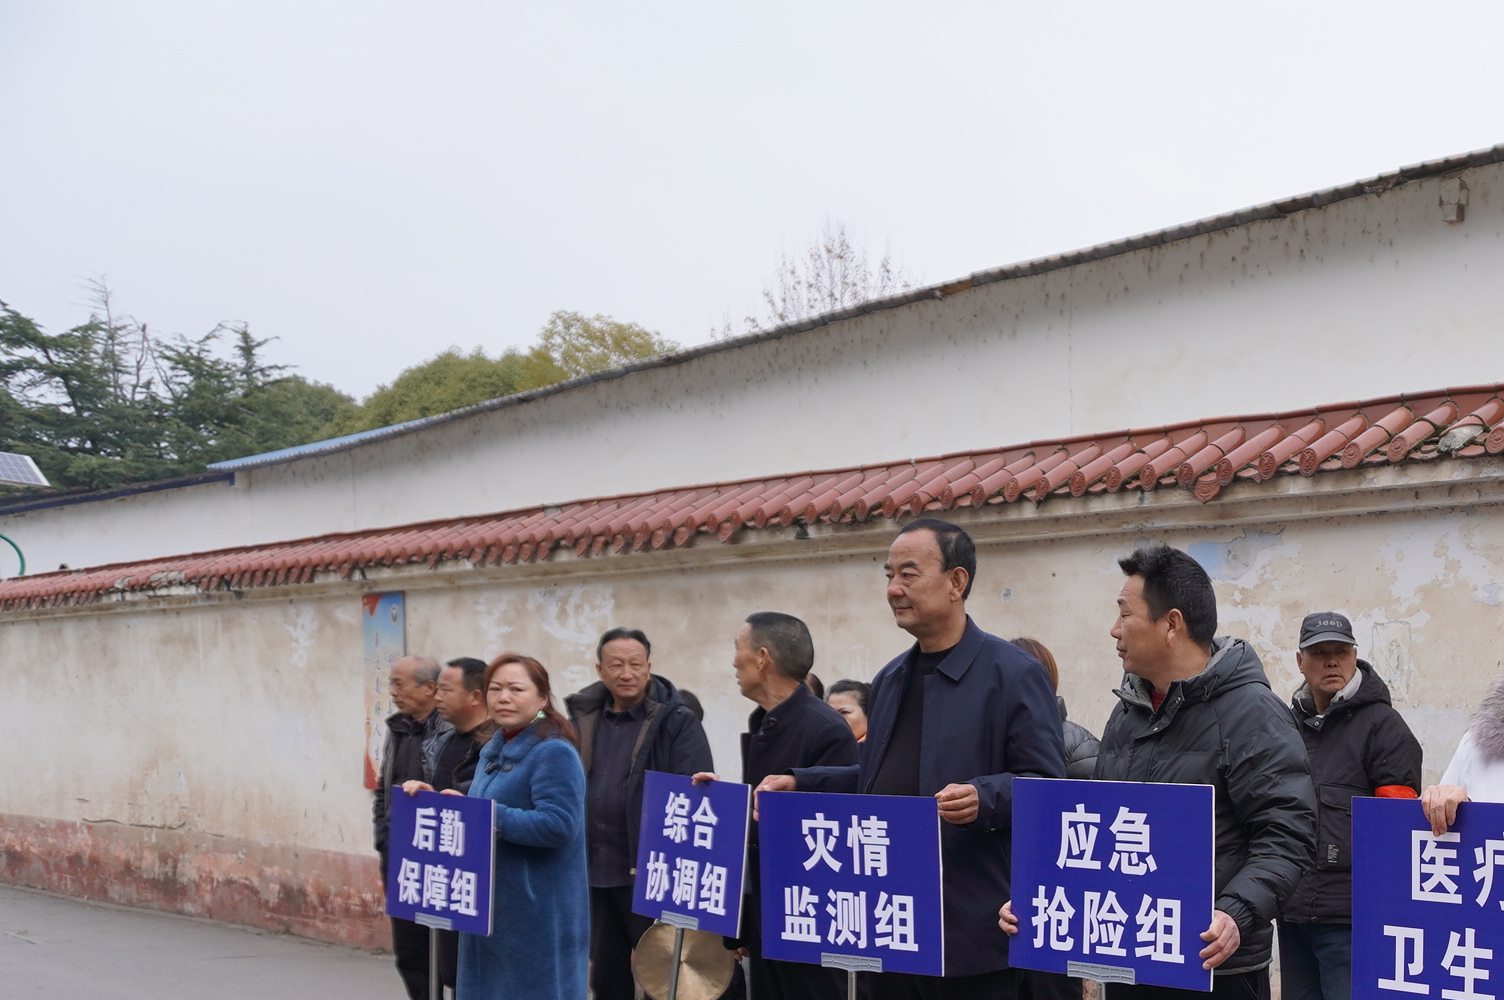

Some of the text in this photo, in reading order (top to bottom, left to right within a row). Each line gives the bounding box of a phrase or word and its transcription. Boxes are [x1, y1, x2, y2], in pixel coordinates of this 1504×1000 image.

[411, 807, 465, 857] 后勤
[662, 791, 719, 850] 综合
[801, 812, 891, 877] 灾情
[1055, 803, 1158, 876] 应急
[397, 857, 479, 917] 保障组
[645, 851, 728, 916] 协调组
[780, 885, 920, 953] 监测组
[1031, 884, 1186, 964] 抢险组
